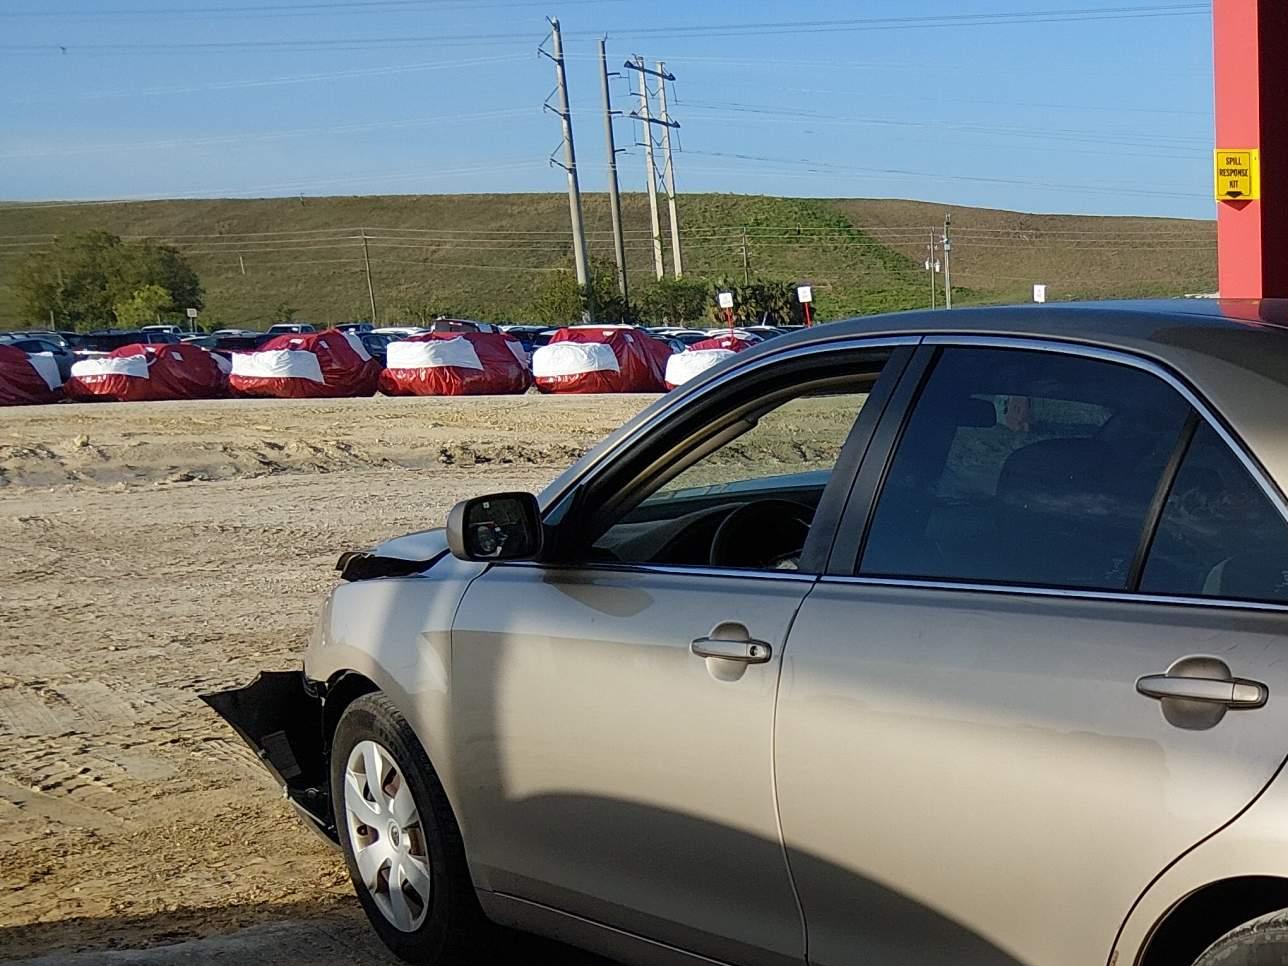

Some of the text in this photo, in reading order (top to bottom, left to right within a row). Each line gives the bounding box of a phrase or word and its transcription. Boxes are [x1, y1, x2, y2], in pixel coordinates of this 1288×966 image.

[1226, 157, 1241, 165] SPILL
[1219, 169, 1248, 177] RESPONSE
[1229, 180, 1239, 188] KIT
